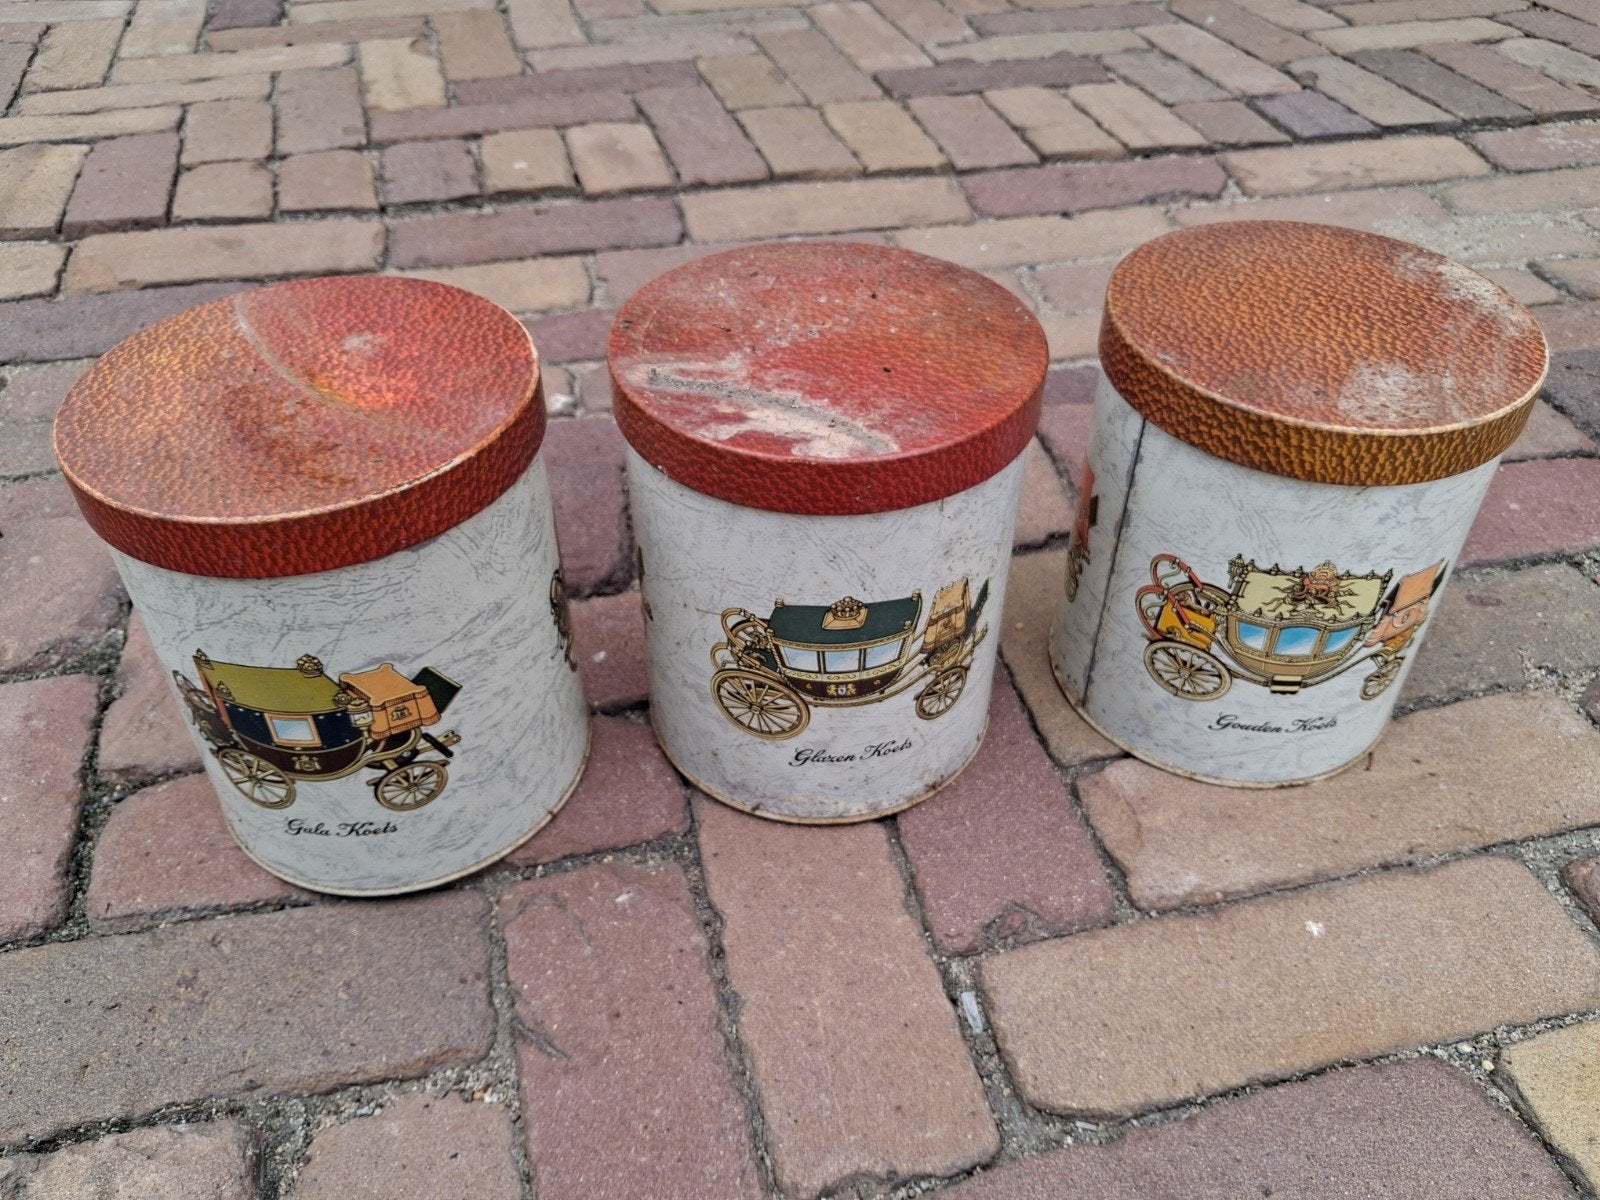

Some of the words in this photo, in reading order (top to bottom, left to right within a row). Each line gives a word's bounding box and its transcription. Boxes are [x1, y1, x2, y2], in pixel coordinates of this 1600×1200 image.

[1207, 712, 1282, 733] Gouden
[1284, 716, 1337, 733] Koets
[788, 747, 856, 767] Glazen
[859, 738, 912, 760] Koets
[284, 817, 331, 836] Gala
[335, 821, 398, 837] Koets
